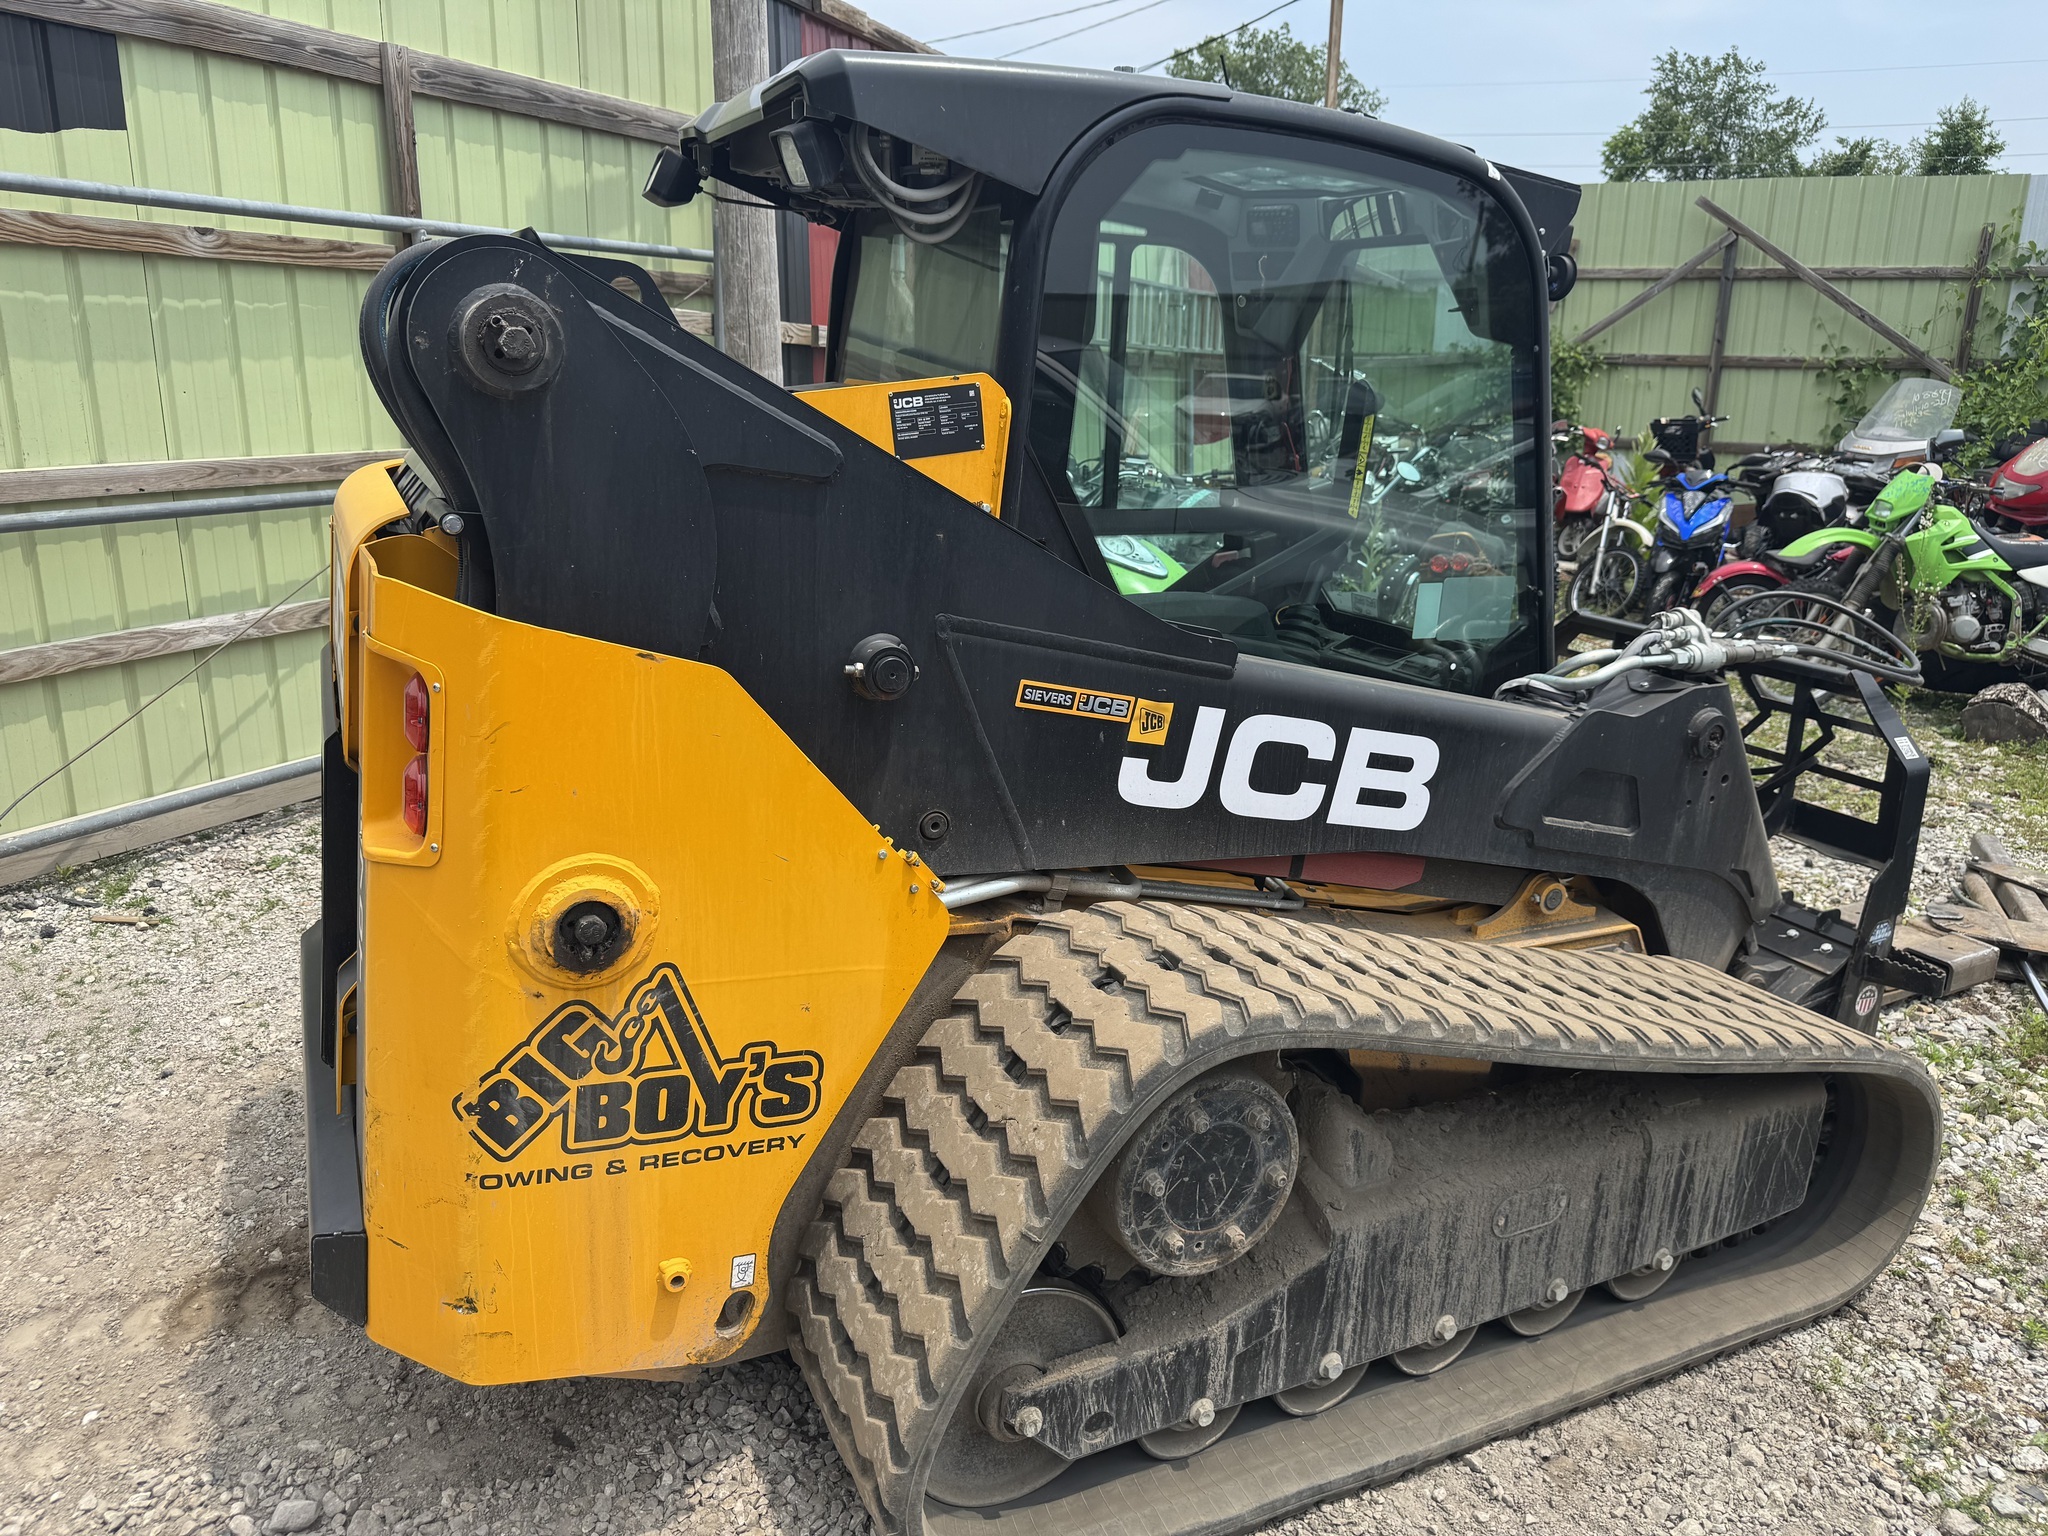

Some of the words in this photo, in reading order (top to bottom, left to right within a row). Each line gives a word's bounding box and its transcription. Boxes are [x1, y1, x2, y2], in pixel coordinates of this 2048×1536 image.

[893, 396, 924, 409] JCB
[1023, 688, 1073, 706] SIEVERS
[1078, 695, 1129, 717] JCB
[1141, 711, 1164, 732] JCB
[1118, 706, 1441, 831] JCB
[463, 1010, 619, 1151] BIG
[573, 1043, 814, 1144] BOY'S
[465, 1163, 593, 1190] OWING
[605, 1159, 628, 1176] &
[639, 1133, 806, 1171] RECOVERY
